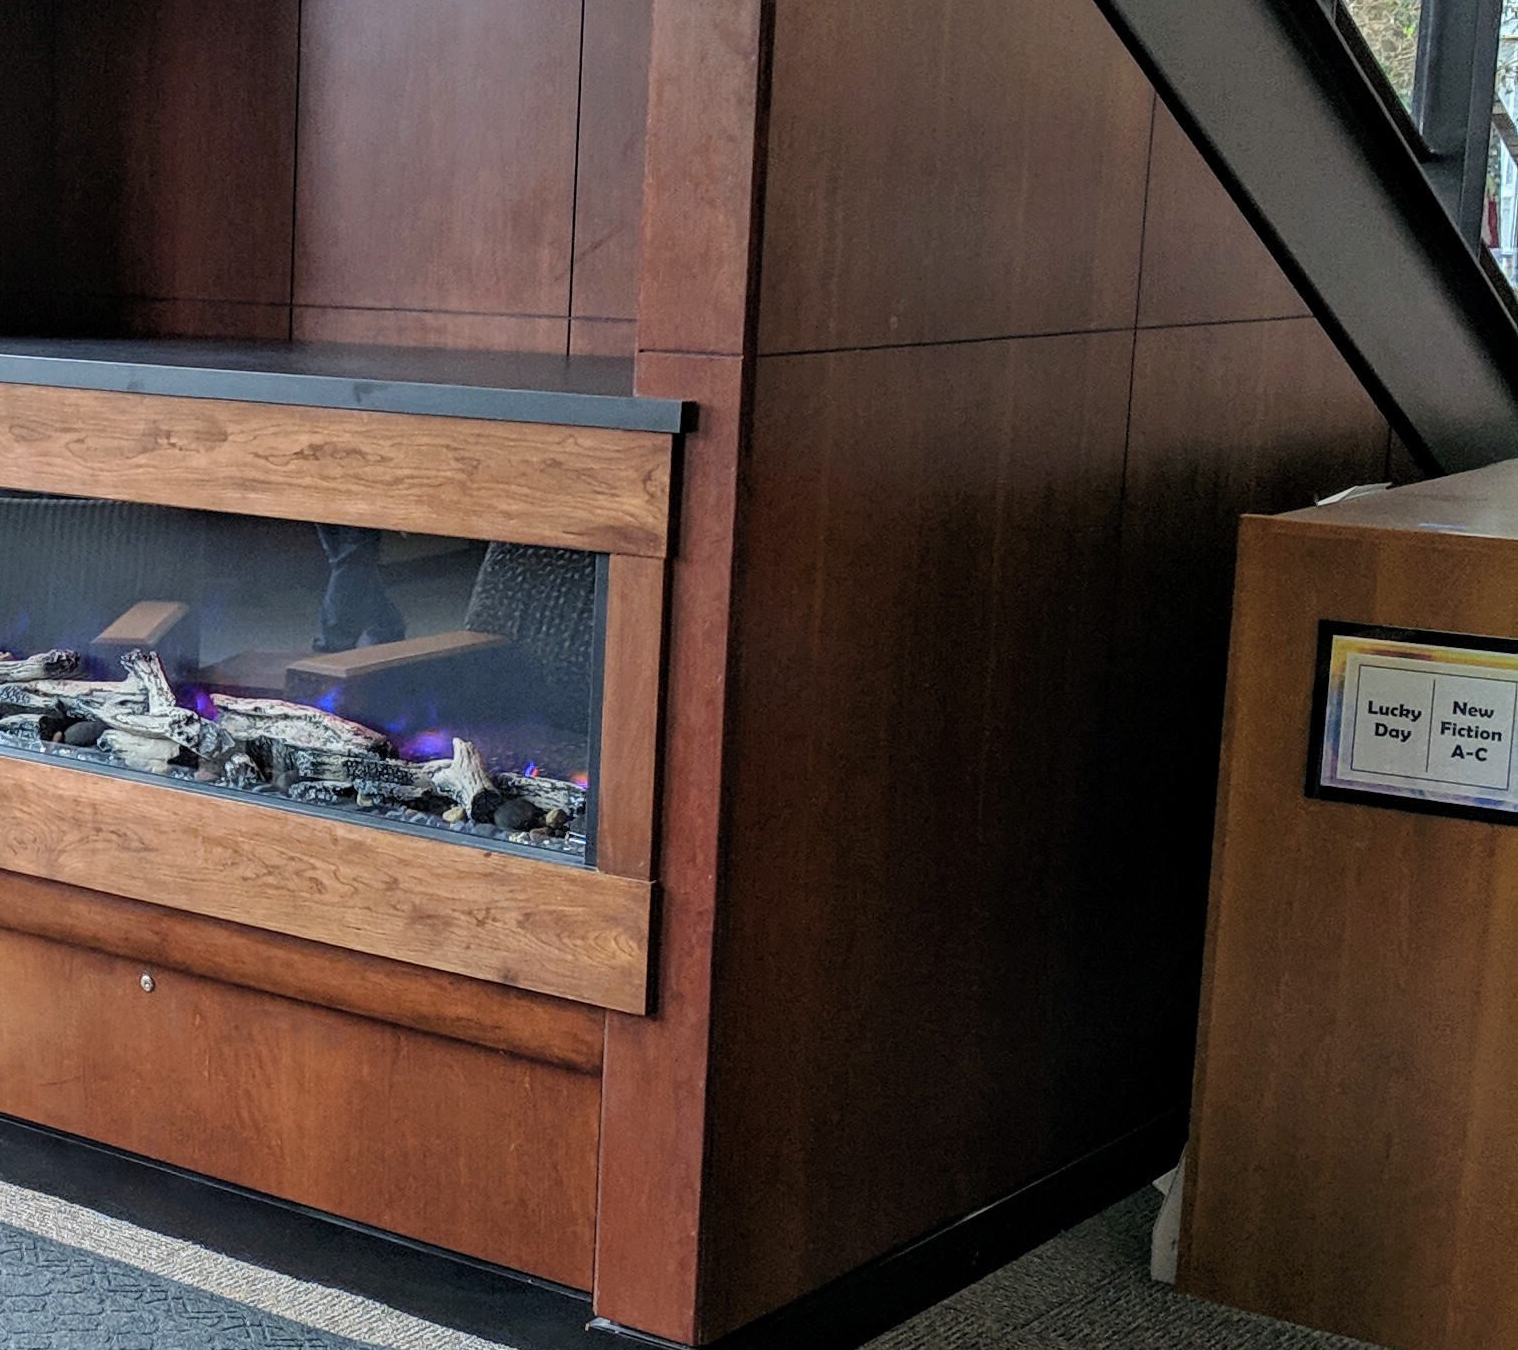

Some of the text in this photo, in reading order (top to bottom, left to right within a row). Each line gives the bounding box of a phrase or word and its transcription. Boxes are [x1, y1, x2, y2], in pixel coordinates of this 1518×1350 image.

[1368, 700, 1422, 722] Lucky
[1452, 701, 1494, 719] New
[1374, 723, 1412, 742] Day
[1440, 721, 1502, 742] Fiction
[1451, 744, 1488, 762] A-C
